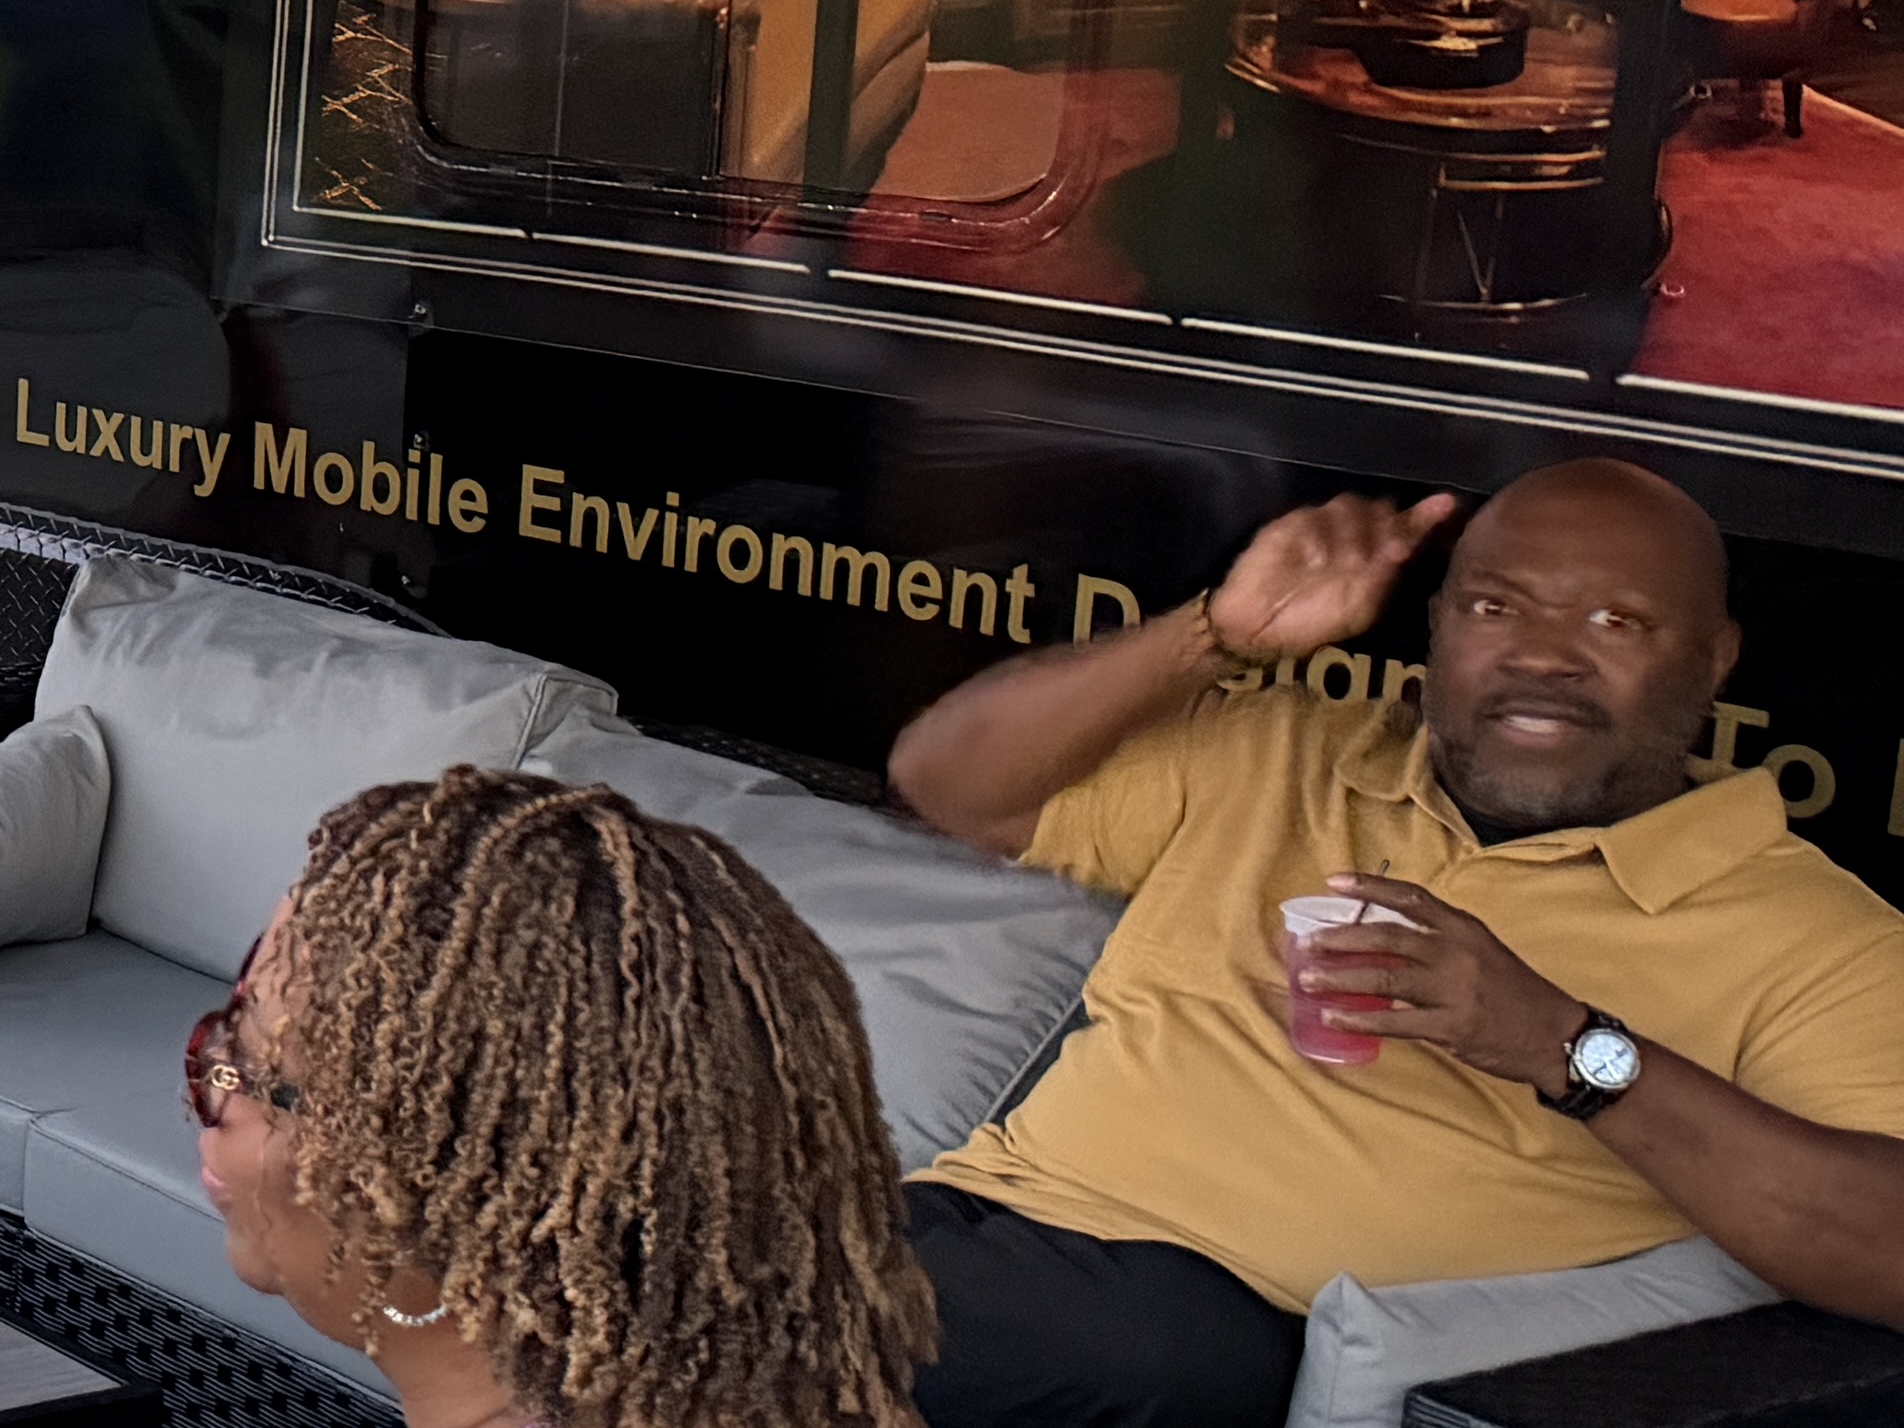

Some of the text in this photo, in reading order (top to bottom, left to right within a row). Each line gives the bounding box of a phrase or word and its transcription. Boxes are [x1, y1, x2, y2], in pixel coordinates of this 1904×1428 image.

[15, 378, 231, 496] Luxury
[253, 422, 490, 534] Mobile
[518, 463, 1036, 644] Environment
